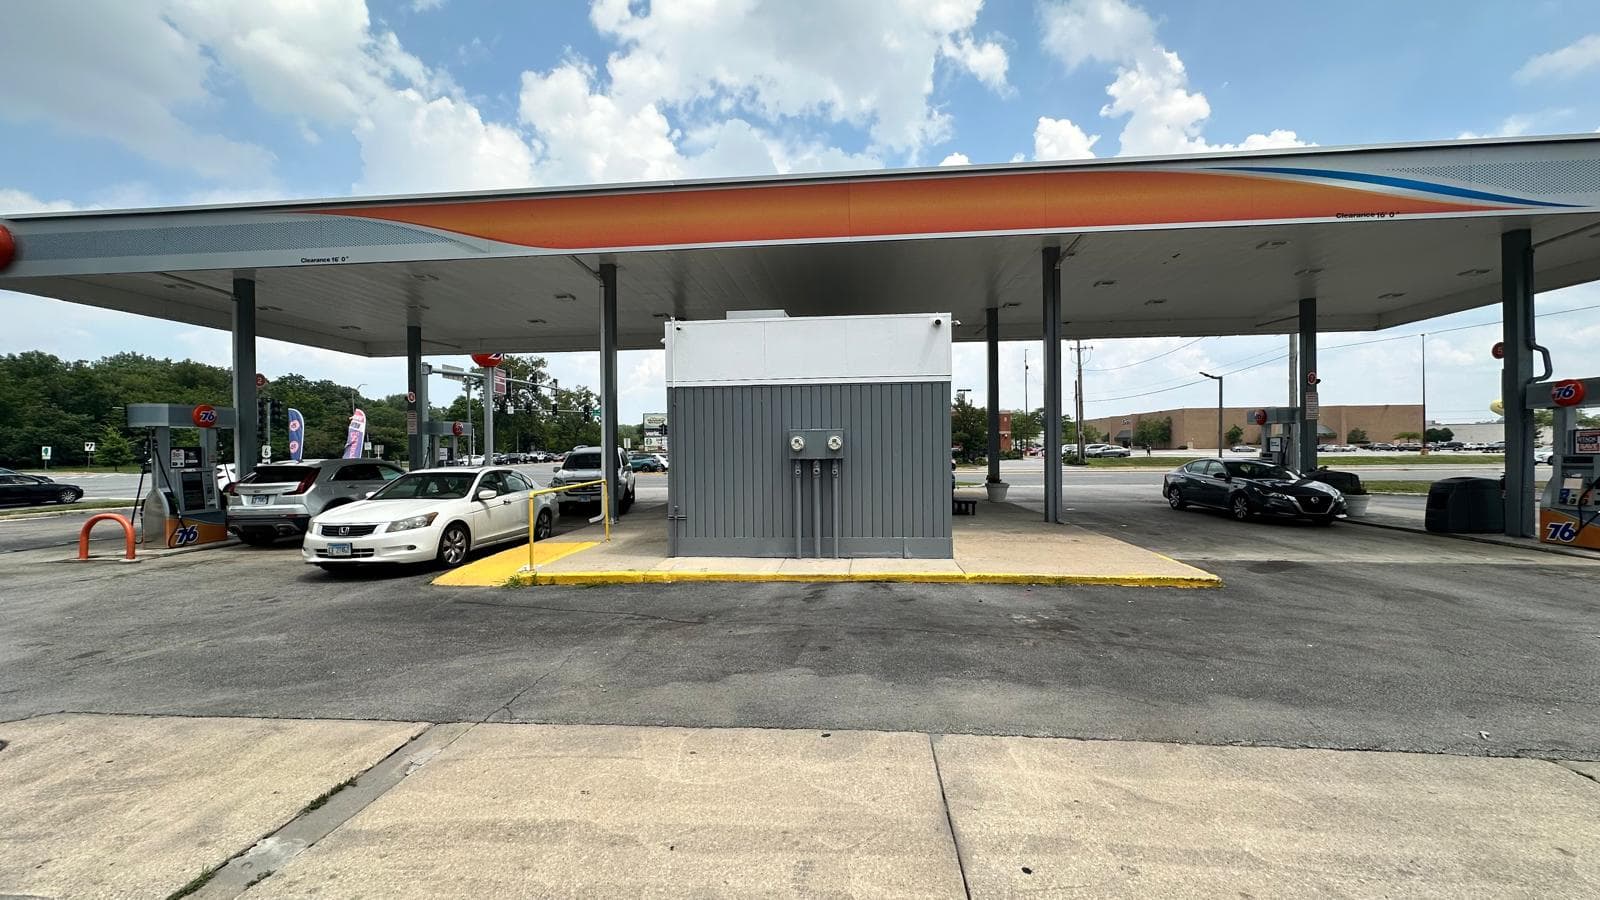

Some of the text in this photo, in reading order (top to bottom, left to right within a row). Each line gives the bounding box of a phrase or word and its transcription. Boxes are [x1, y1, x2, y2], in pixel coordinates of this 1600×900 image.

[1554, 384, 1575, 400] 76
[200, 410, 217, 422] 76
[175, 525, 199, 545] 76
[1547, 521, 1576, 543] 76
